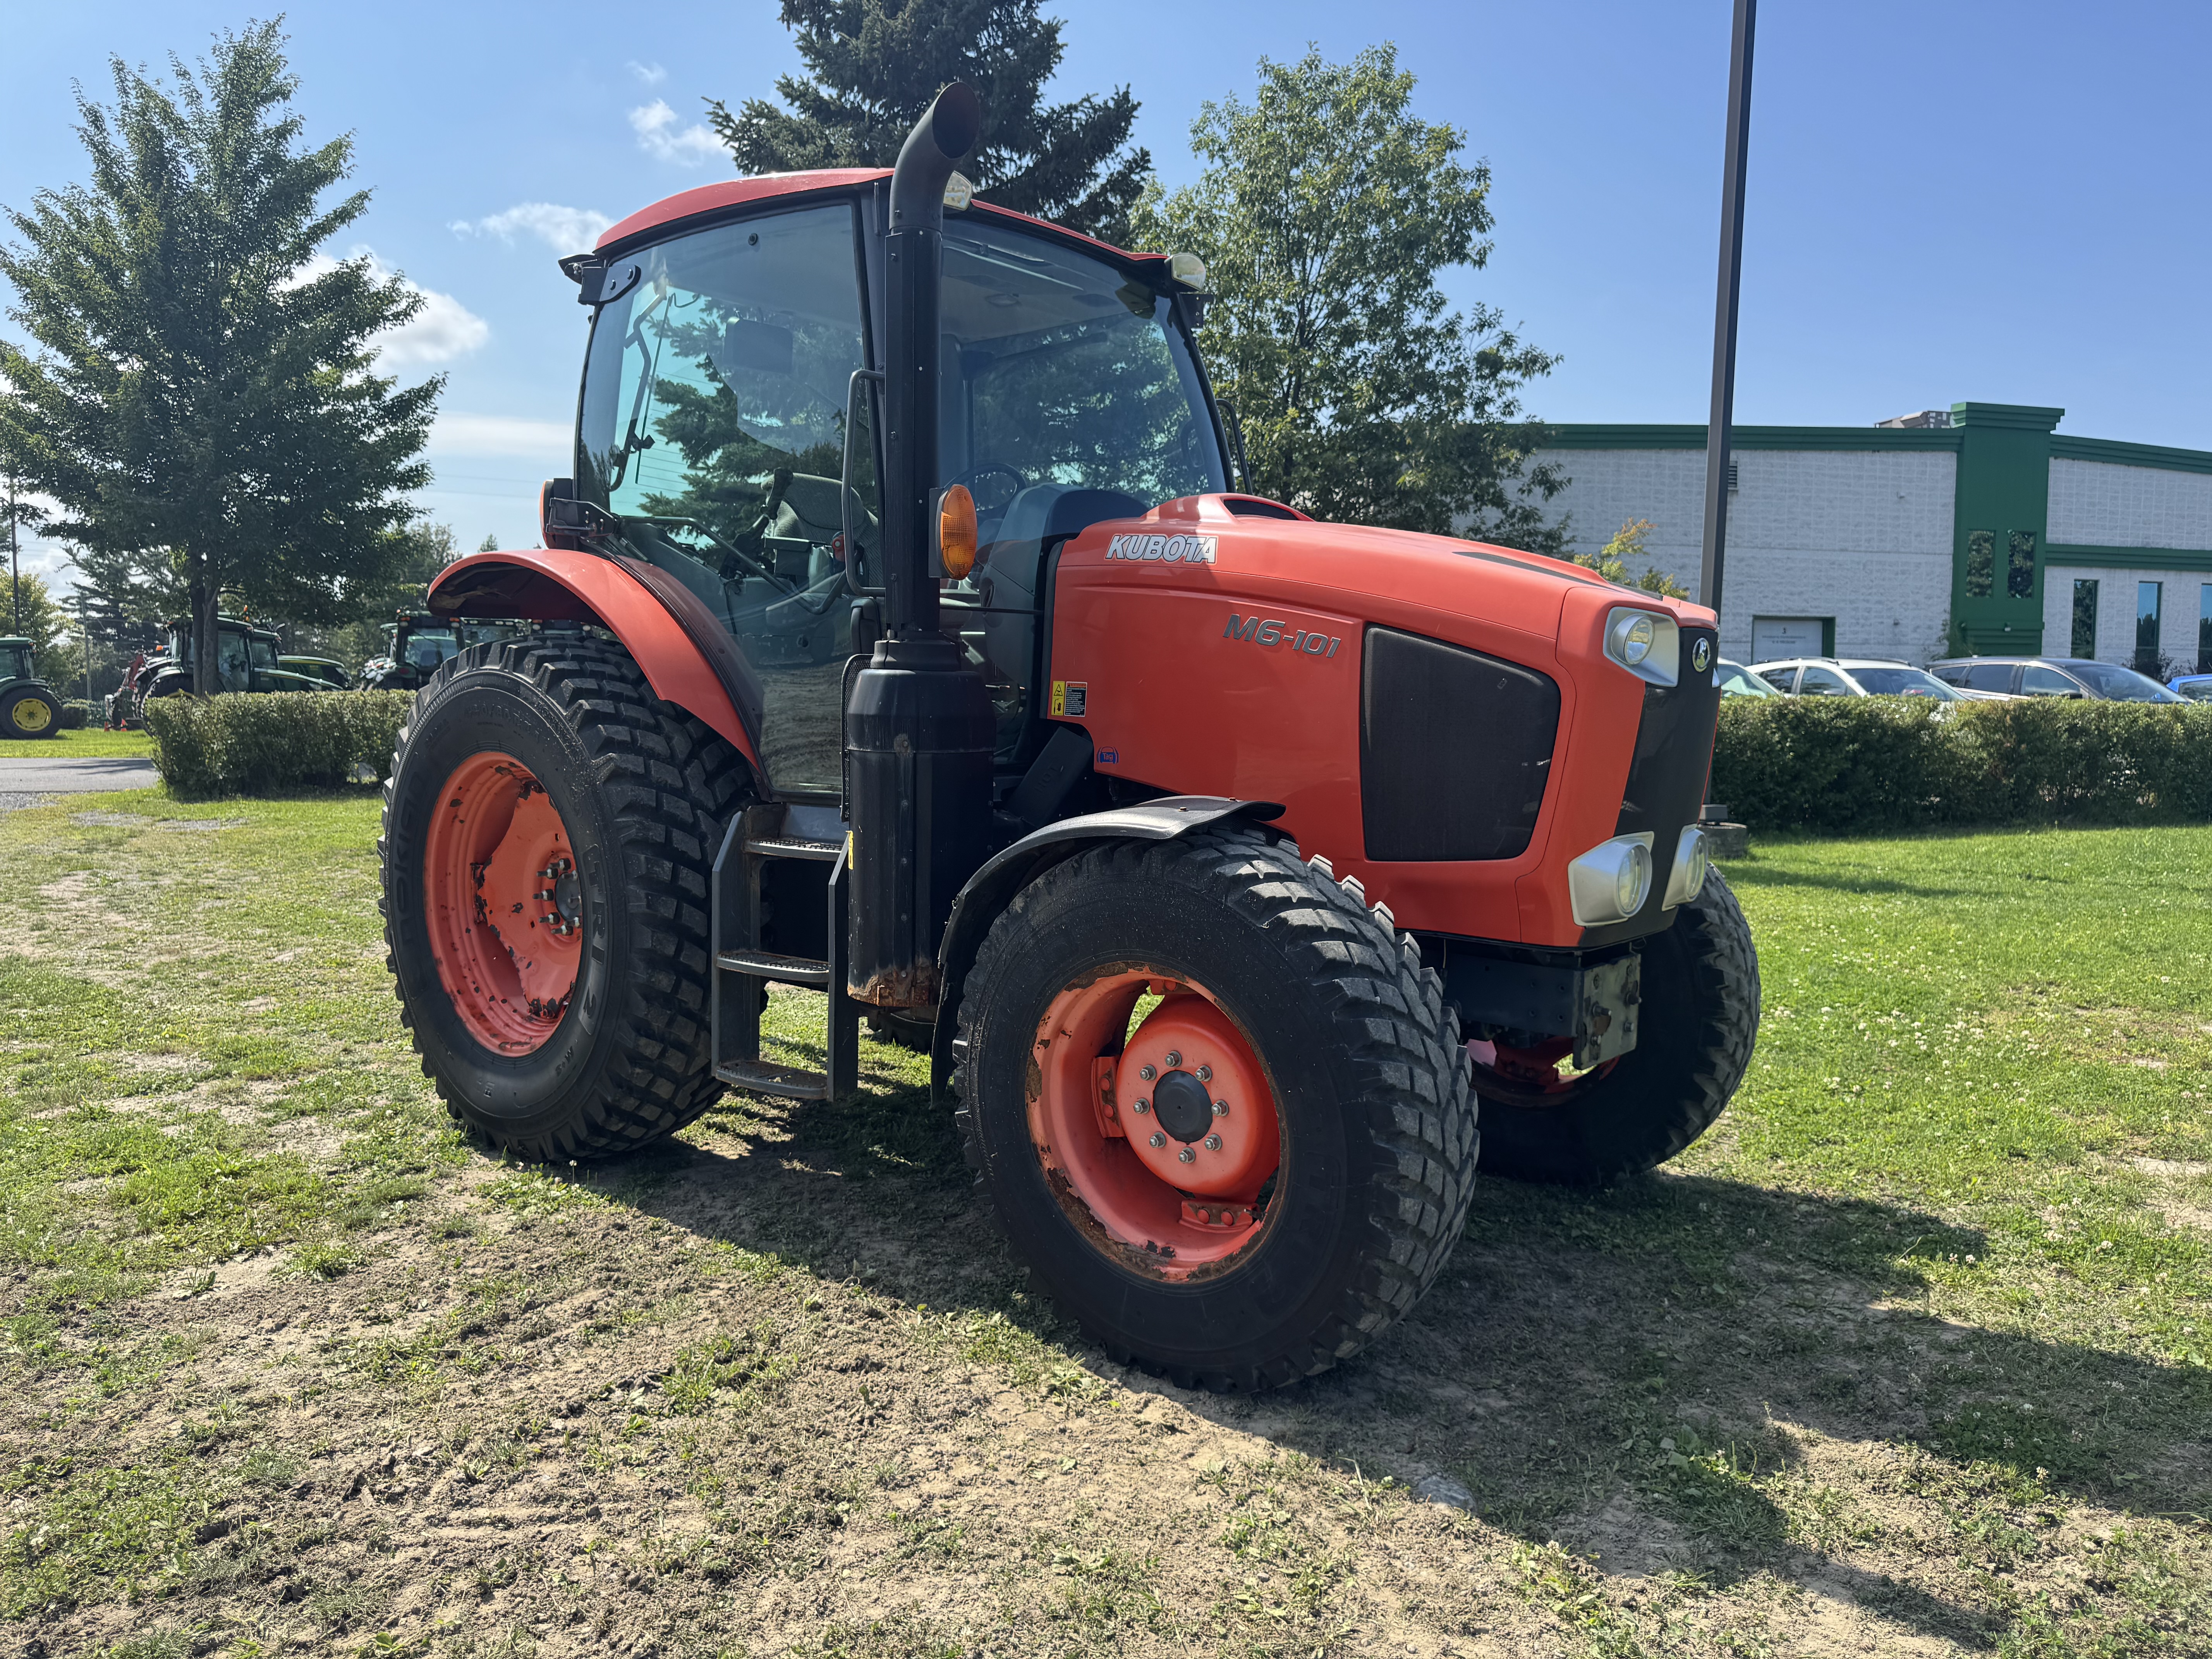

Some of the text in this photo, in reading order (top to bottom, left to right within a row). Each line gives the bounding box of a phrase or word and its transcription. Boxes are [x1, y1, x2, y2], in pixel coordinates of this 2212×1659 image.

[1105, 534, 1217, 564] KUBOTA
[1223, 614, 1341, 658] M6-101
[1103, 752, 1113, 761] Tag
[1034, 763, 1058, 793] HOT
[589, 861, 605, 964] TRI
